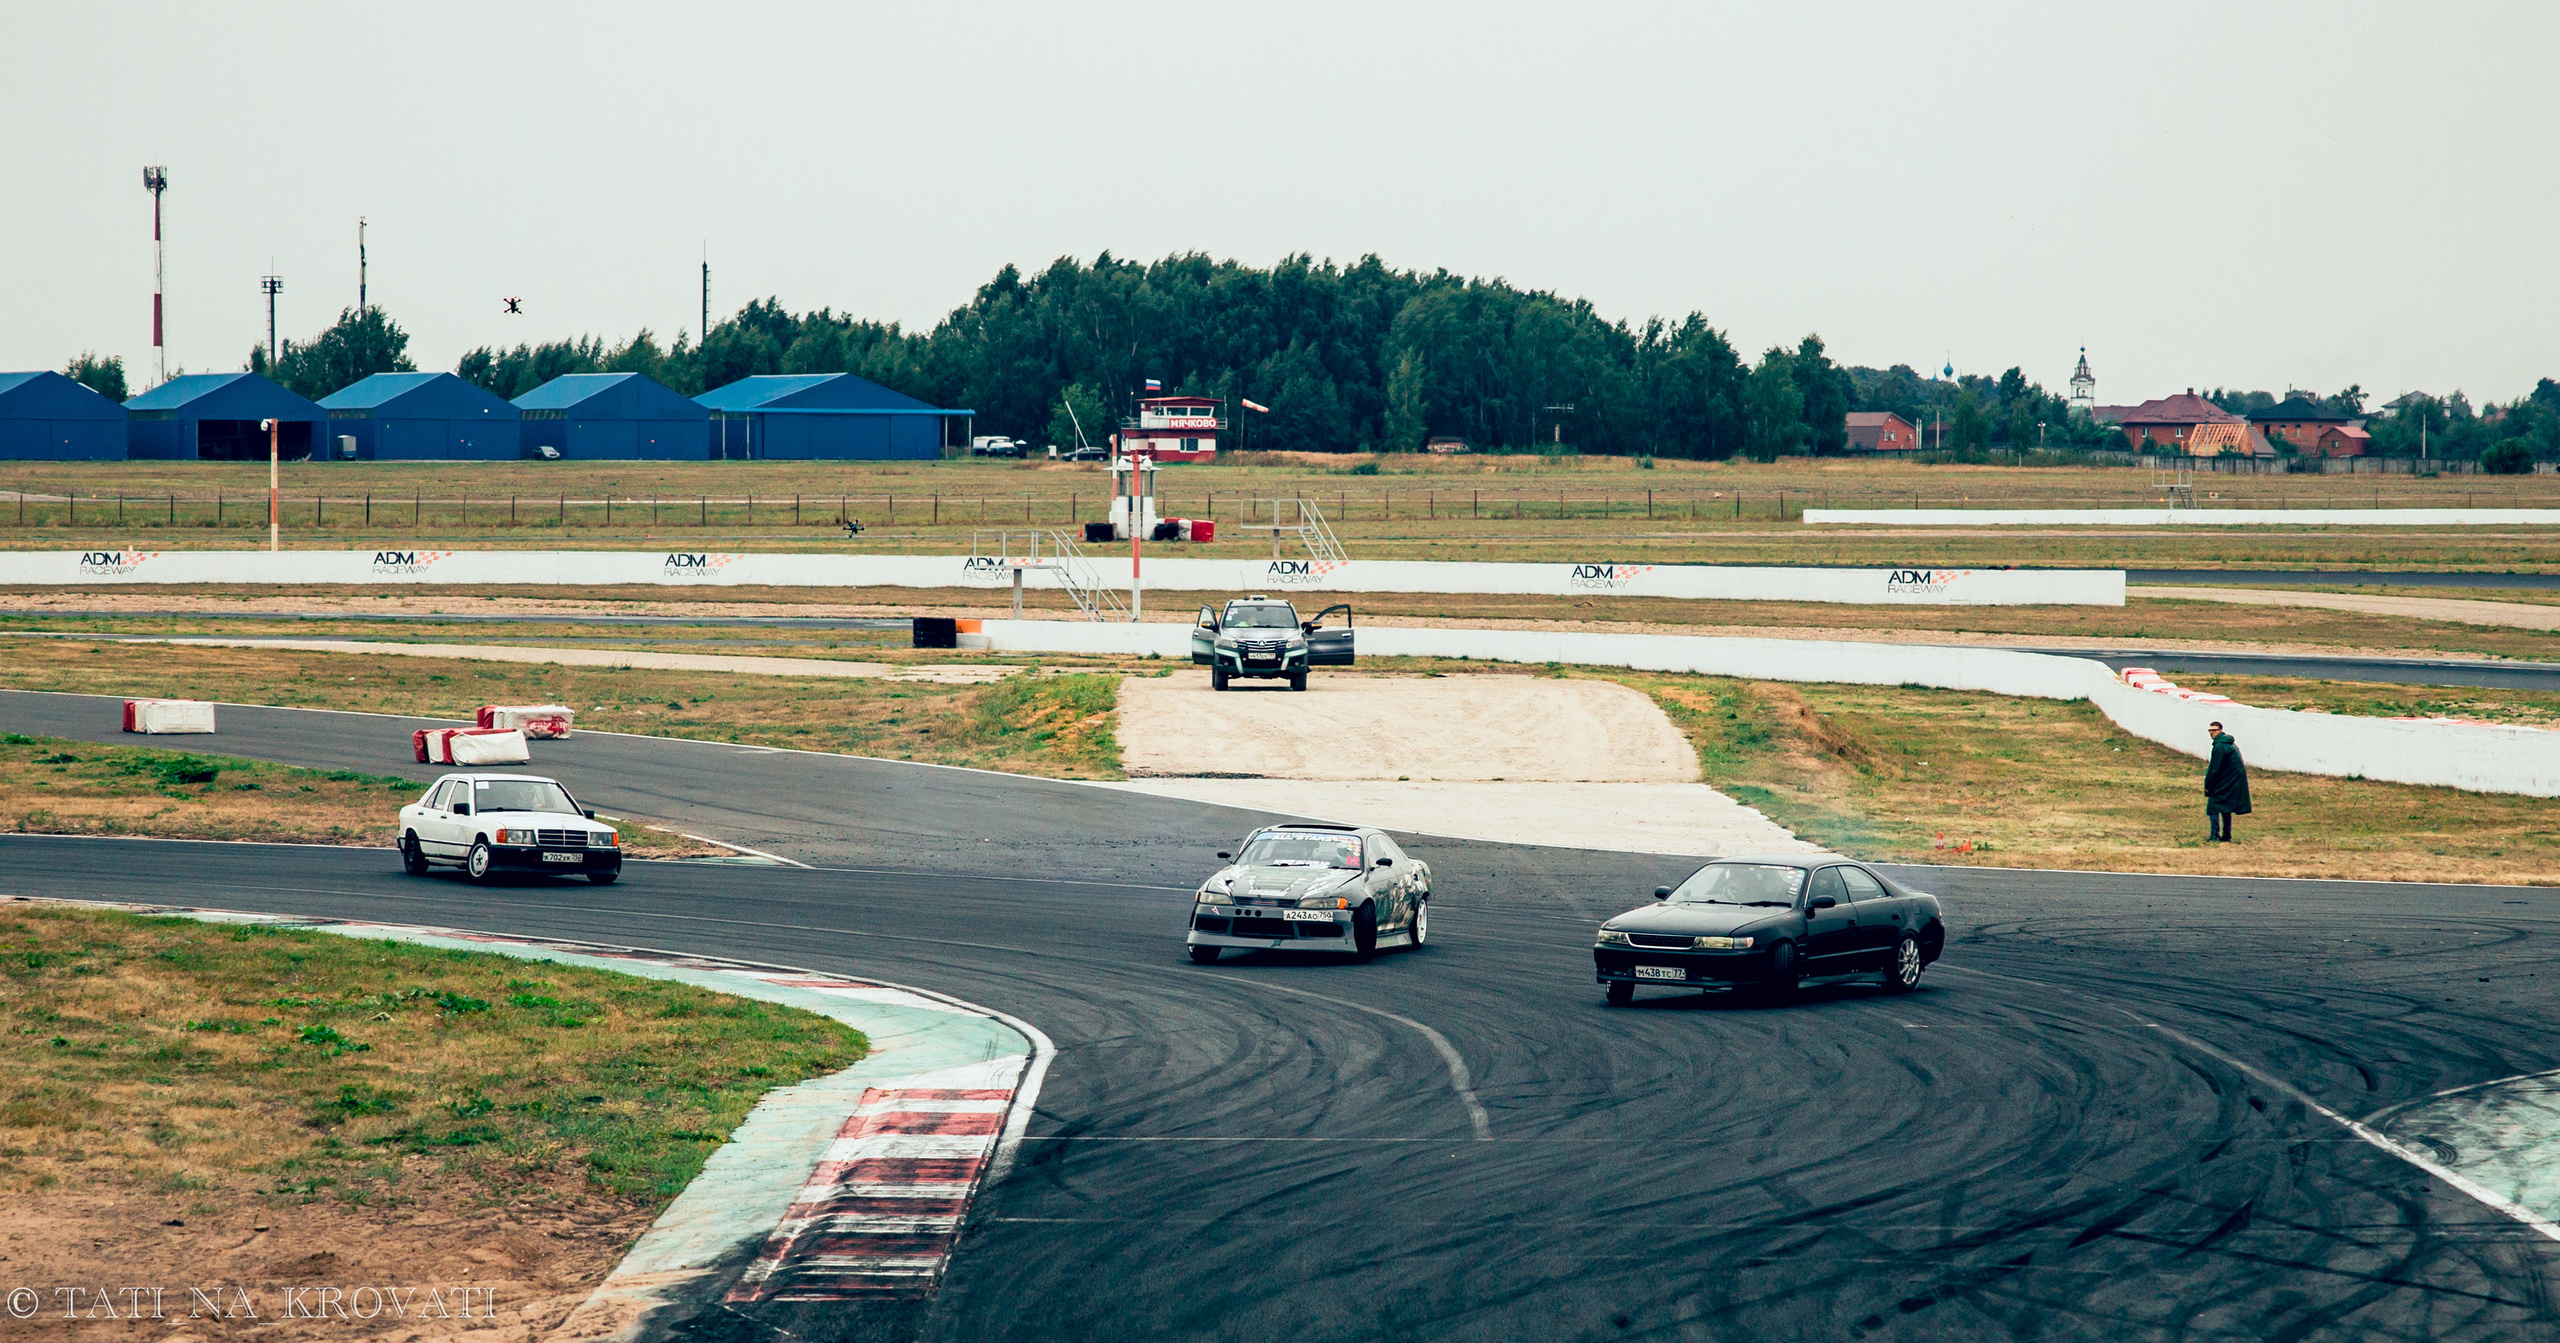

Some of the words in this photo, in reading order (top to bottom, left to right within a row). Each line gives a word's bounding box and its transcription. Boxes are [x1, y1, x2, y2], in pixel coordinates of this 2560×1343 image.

[1170, 419, 1217, 428] МЯЧКОВО
[80, 552, 121, 566] ADM
[373, 552, 414, 565] ADM
[665, 553, 706, 567] ADM
[963, 557, 1004, 571] ADM
[1267, 561, 1309, 575] ADM
[79, 566, 137, 575] RACEWAY
[372, 565, 430, 575] RACEWAY
[663, 567, 721, 577] RACEWAY
[1571, 565, 1613, 579] ADM
[962, 571, 1014, 580] RACEWA
[1266, 575, 1324, 585] RACEWAY
[1888, 570, 1931, 584] ADM
[1570, 579, 1629, 589] RACEWAY
[1887, 584, 1947, 594] RACEWAY
